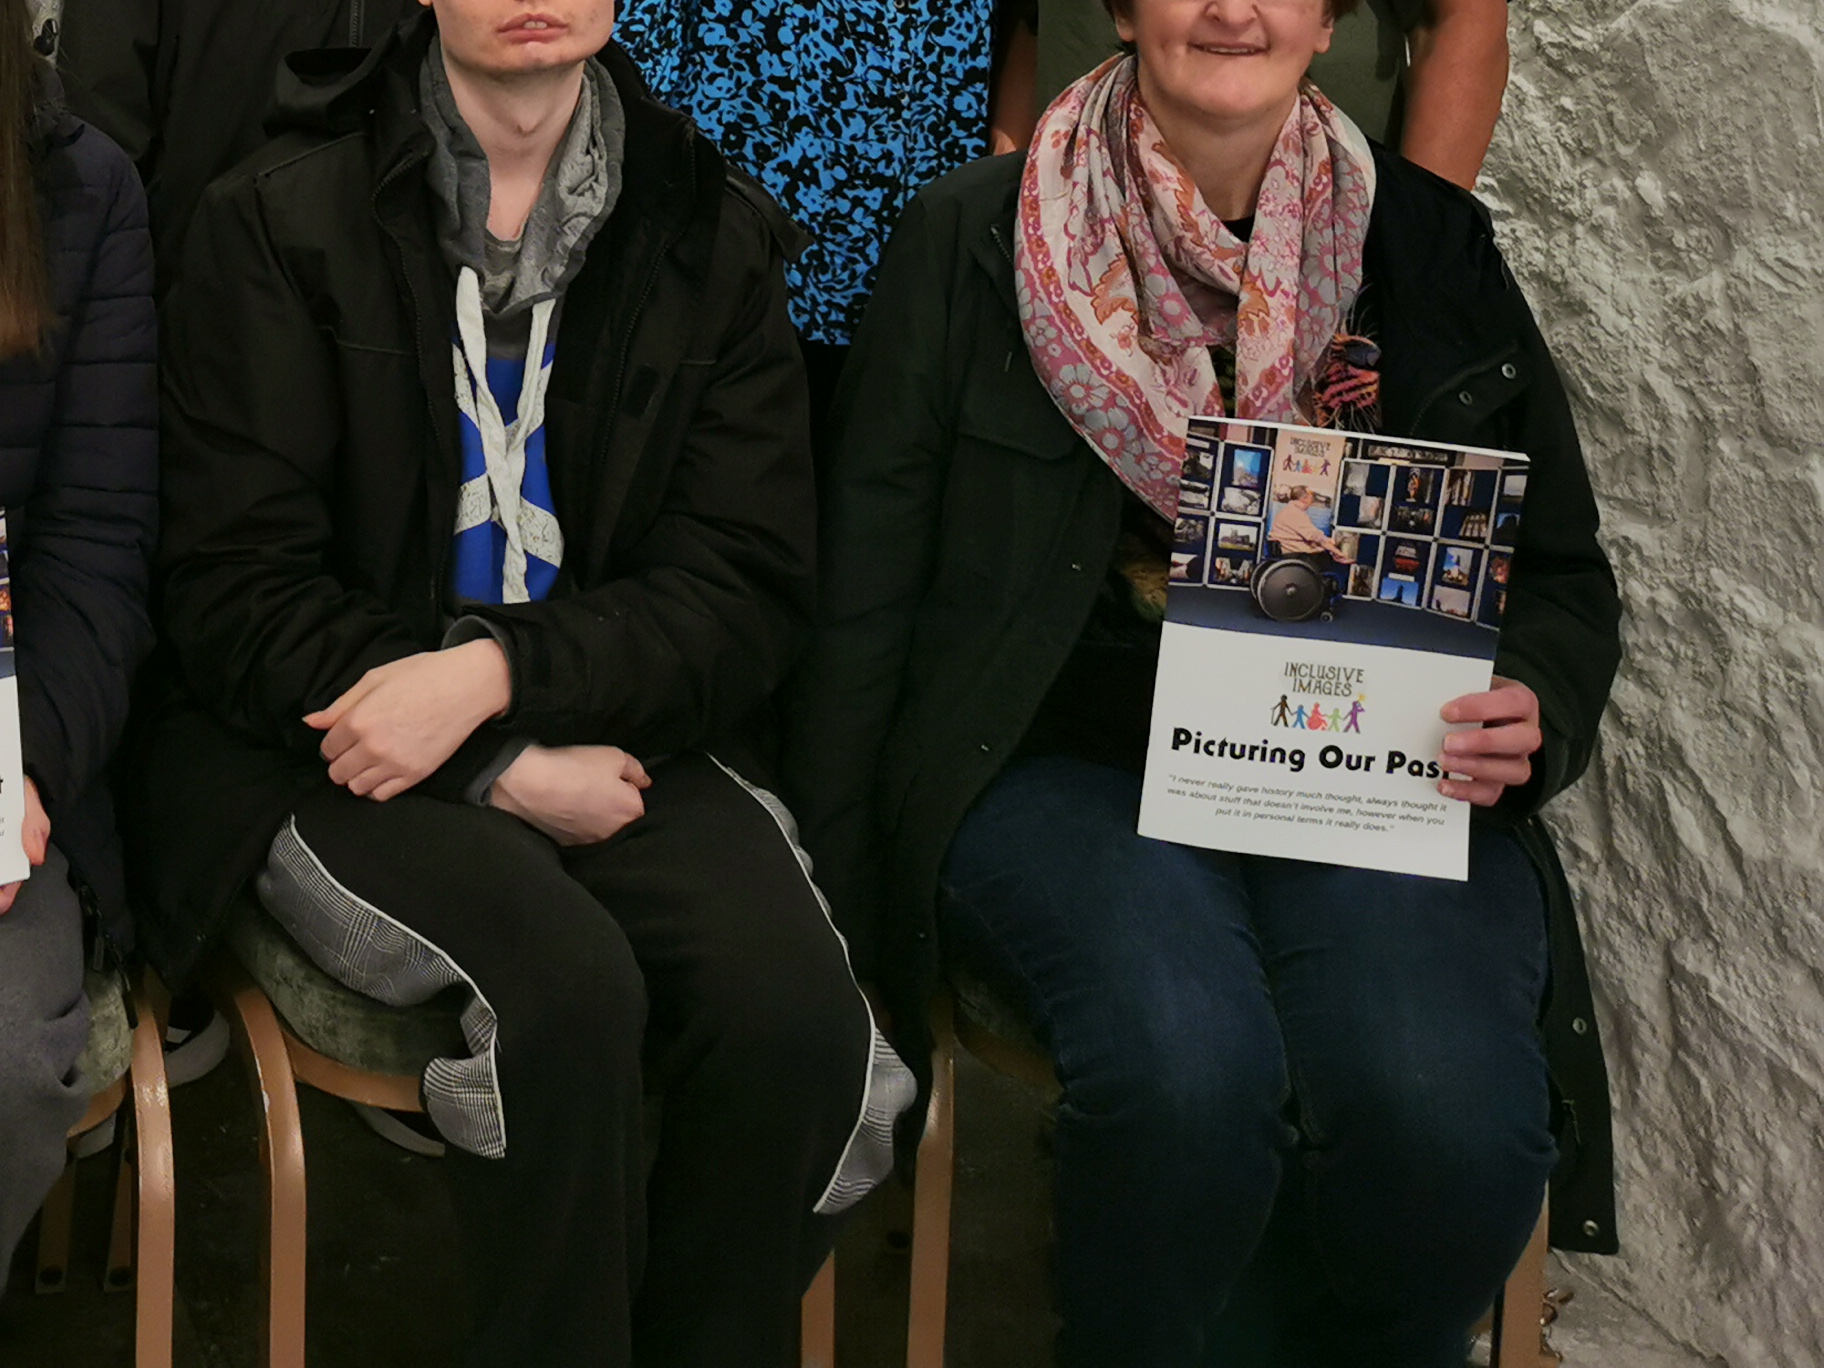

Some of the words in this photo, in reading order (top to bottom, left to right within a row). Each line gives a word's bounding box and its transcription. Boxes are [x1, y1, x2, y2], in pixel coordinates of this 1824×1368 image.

[1283, 661, 1364, 684] INCLUSIVE
[1292, 678, 1353, 697] IMAGES
[1171, 727, 1306, 771] Picturing
[1319, 744, 1376, 773] Our
[1386, 750, 1448, 780] Pas
[1178, 777, 1206, 786] never
[1207, 781, 1234, 792] really
[1236, 785, 1259, 794] gave
[1261, 786, 1295, 799] history
[1296, 790, 1322, 799] much
[1325, 793, 1363, 805] thought,
[1366, 797, 1398, 808] always
[1401, 800, 1438, 812] thought
[1440, 804, 1447, 812] it
[1189, 791, 1217, 801] about
[1219, 795, 1242, 805] stuff
[1243, 798, 1262, 807] that
[1263, 799, 1299, 810] doesn't
[1300, 803, 1334, 814] involve
[1336, 807, 1353, 817] me,
[1356, 809, 1396, 820] however
[1398, 813, 1424, 823] when
[1426, 817, 1445, 826] you
[1215, 807, 1232, 816] put
[1233, 809, 1240, 817] it
[1242, 809, 1252, 818] in
[1253, 812, 1295, 823] personal
[1297, 816, 1323, 826] terms
[1325, 818, 1332, 826] it
[1334, 819, 1360, 831] really
[0, 817, 5, 825] it
